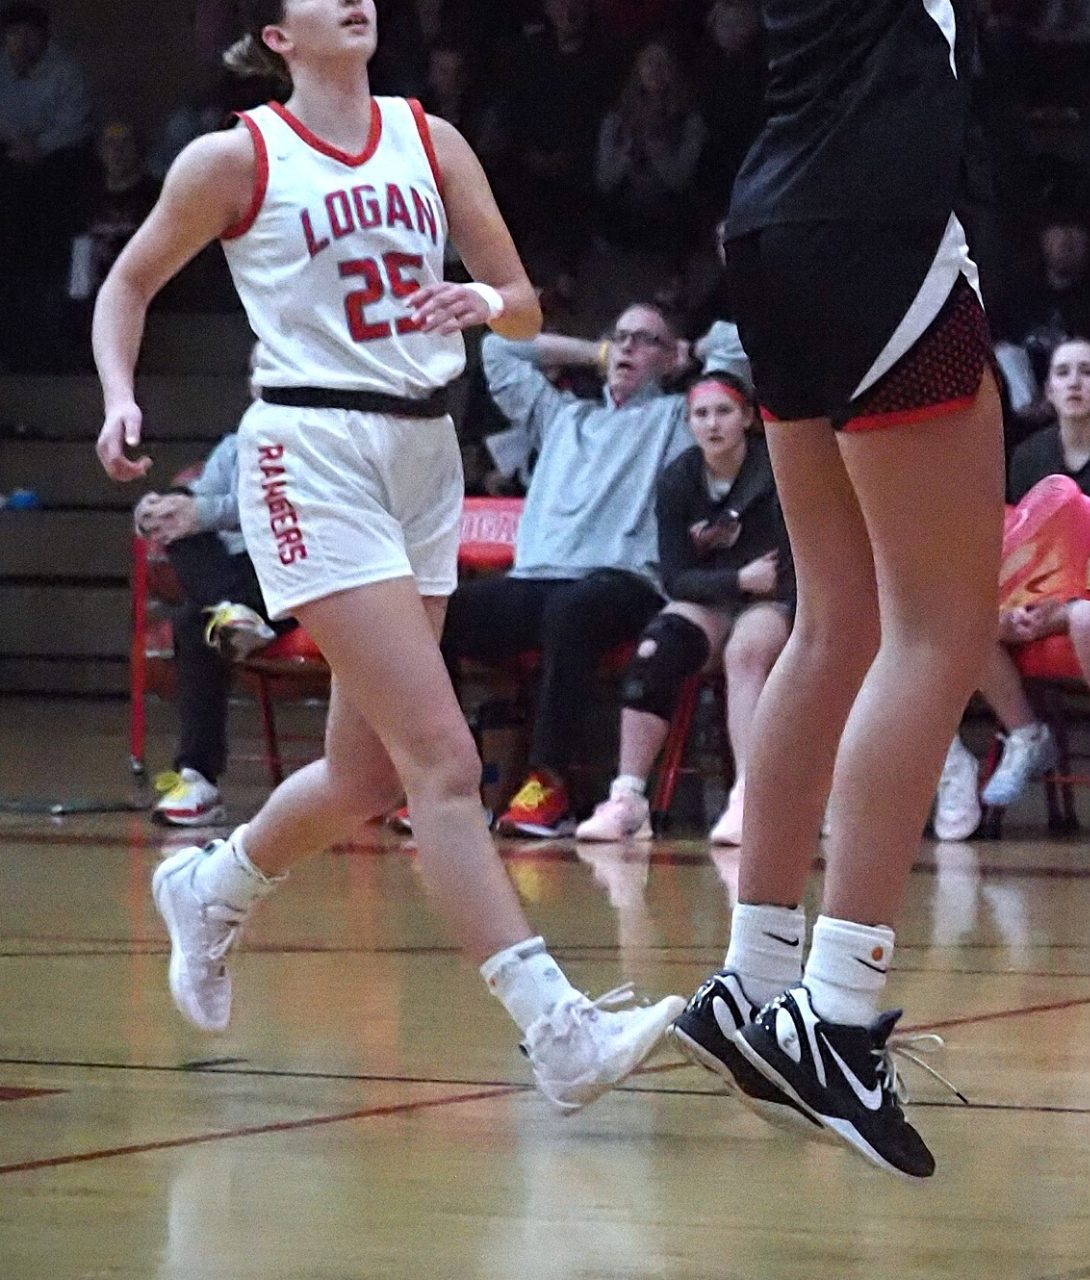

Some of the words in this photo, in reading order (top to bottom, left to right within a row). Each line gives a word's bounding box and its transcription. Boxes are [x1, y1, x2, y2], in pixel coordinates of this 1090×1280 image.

[300, 183, 437, 258] LOGAN
[338, 251, 427, 342] 25
[258, 444, 307, 565] RANGERS
